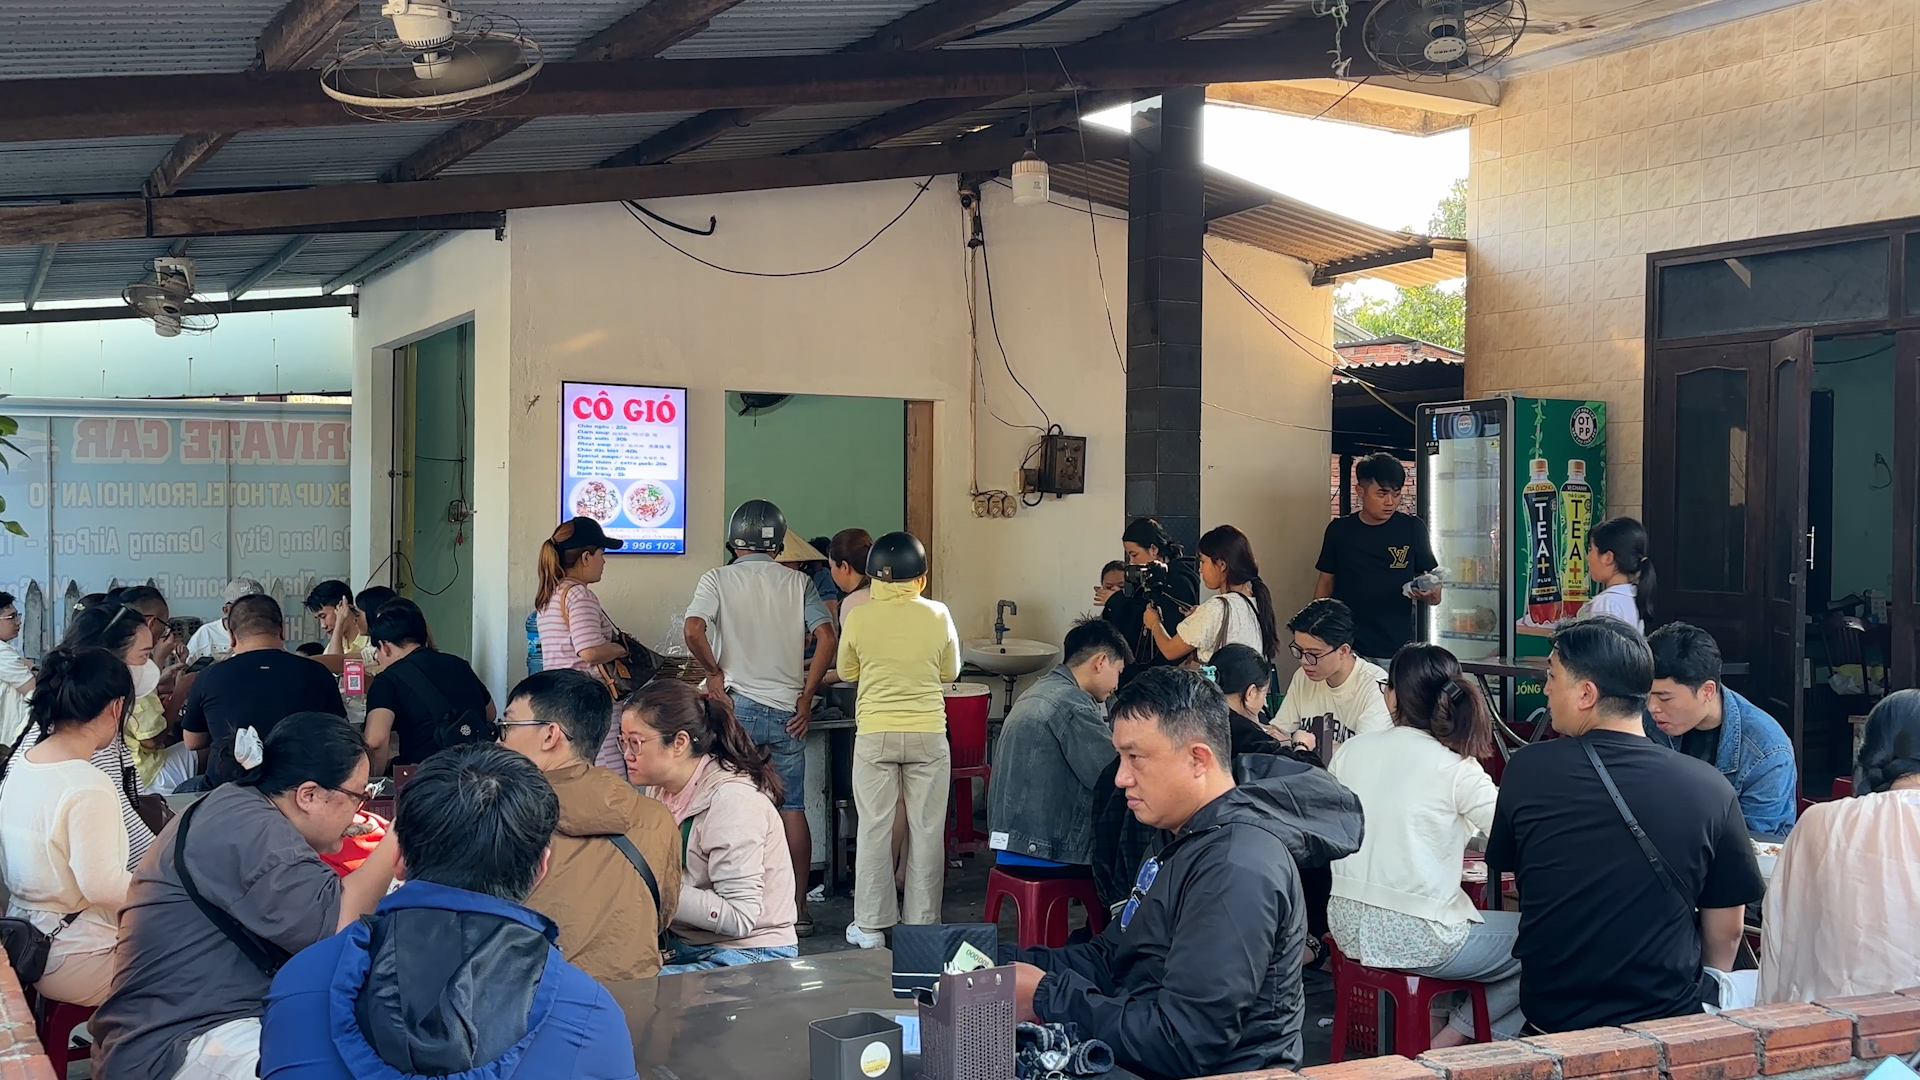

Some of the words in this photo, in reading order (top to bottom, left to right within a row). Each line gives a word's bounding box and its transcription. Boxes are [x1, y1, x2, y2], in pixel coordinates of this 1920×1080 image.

[572, 390, 614, 421] CÔ
[623, 394, 677, 423] GIÓ
[632, 541, 653, 550] 996
[655, 541, 676, 550] 102
